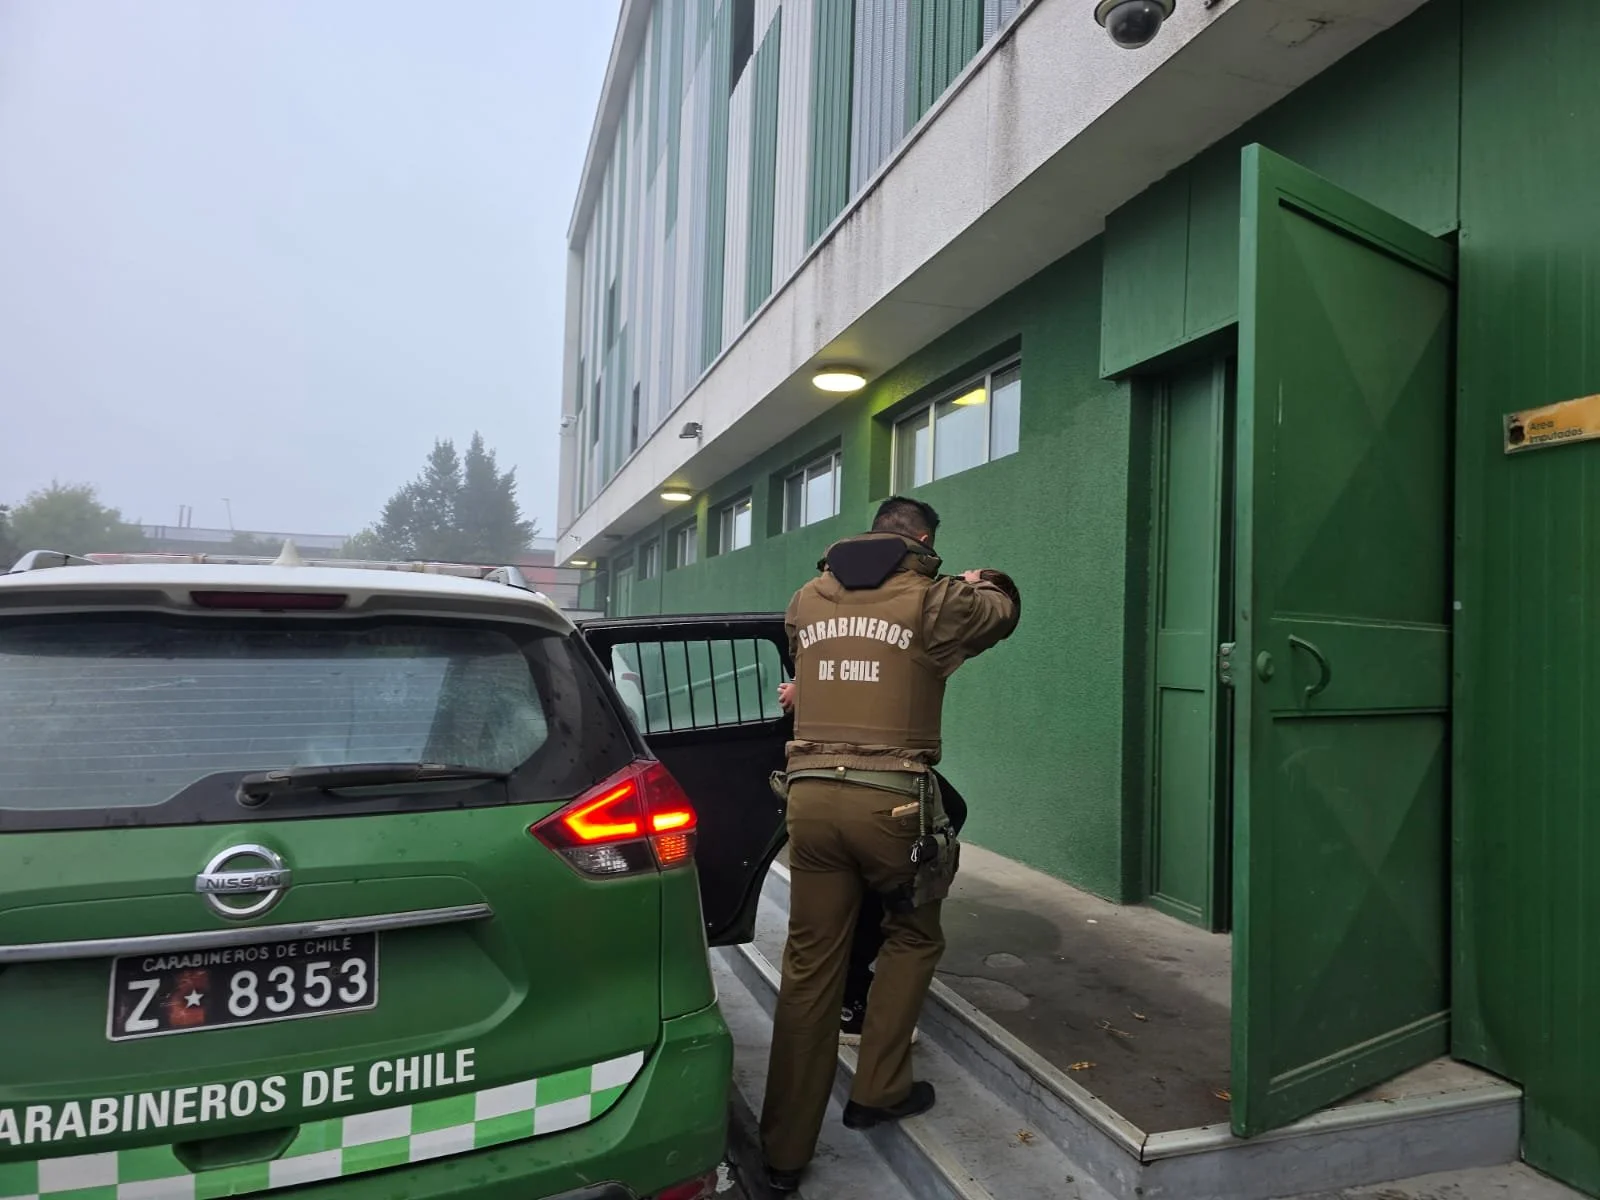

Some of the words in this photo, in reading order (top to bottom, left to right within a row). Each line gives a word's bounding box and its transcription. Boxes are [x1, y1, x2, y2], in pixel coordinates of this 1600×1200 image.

[799, 617, 913, 649] CARABINEROS
[818, 660, 835, 681] DE
[840, 660, 880, 682] CHILE
[205, 875, 282, 890] NISSAN
[142, 947, 269, 972] CARABINEROS
[277, 944, 298, 959] DE
[304, 937, 352, 955] CHILE
[124, 978, 161, 1032] Z
[228, 958, 368, 1017] 8353
[302, 1066, 355, 1109] DE
[368, 1047, 476, 1094] CHILE
